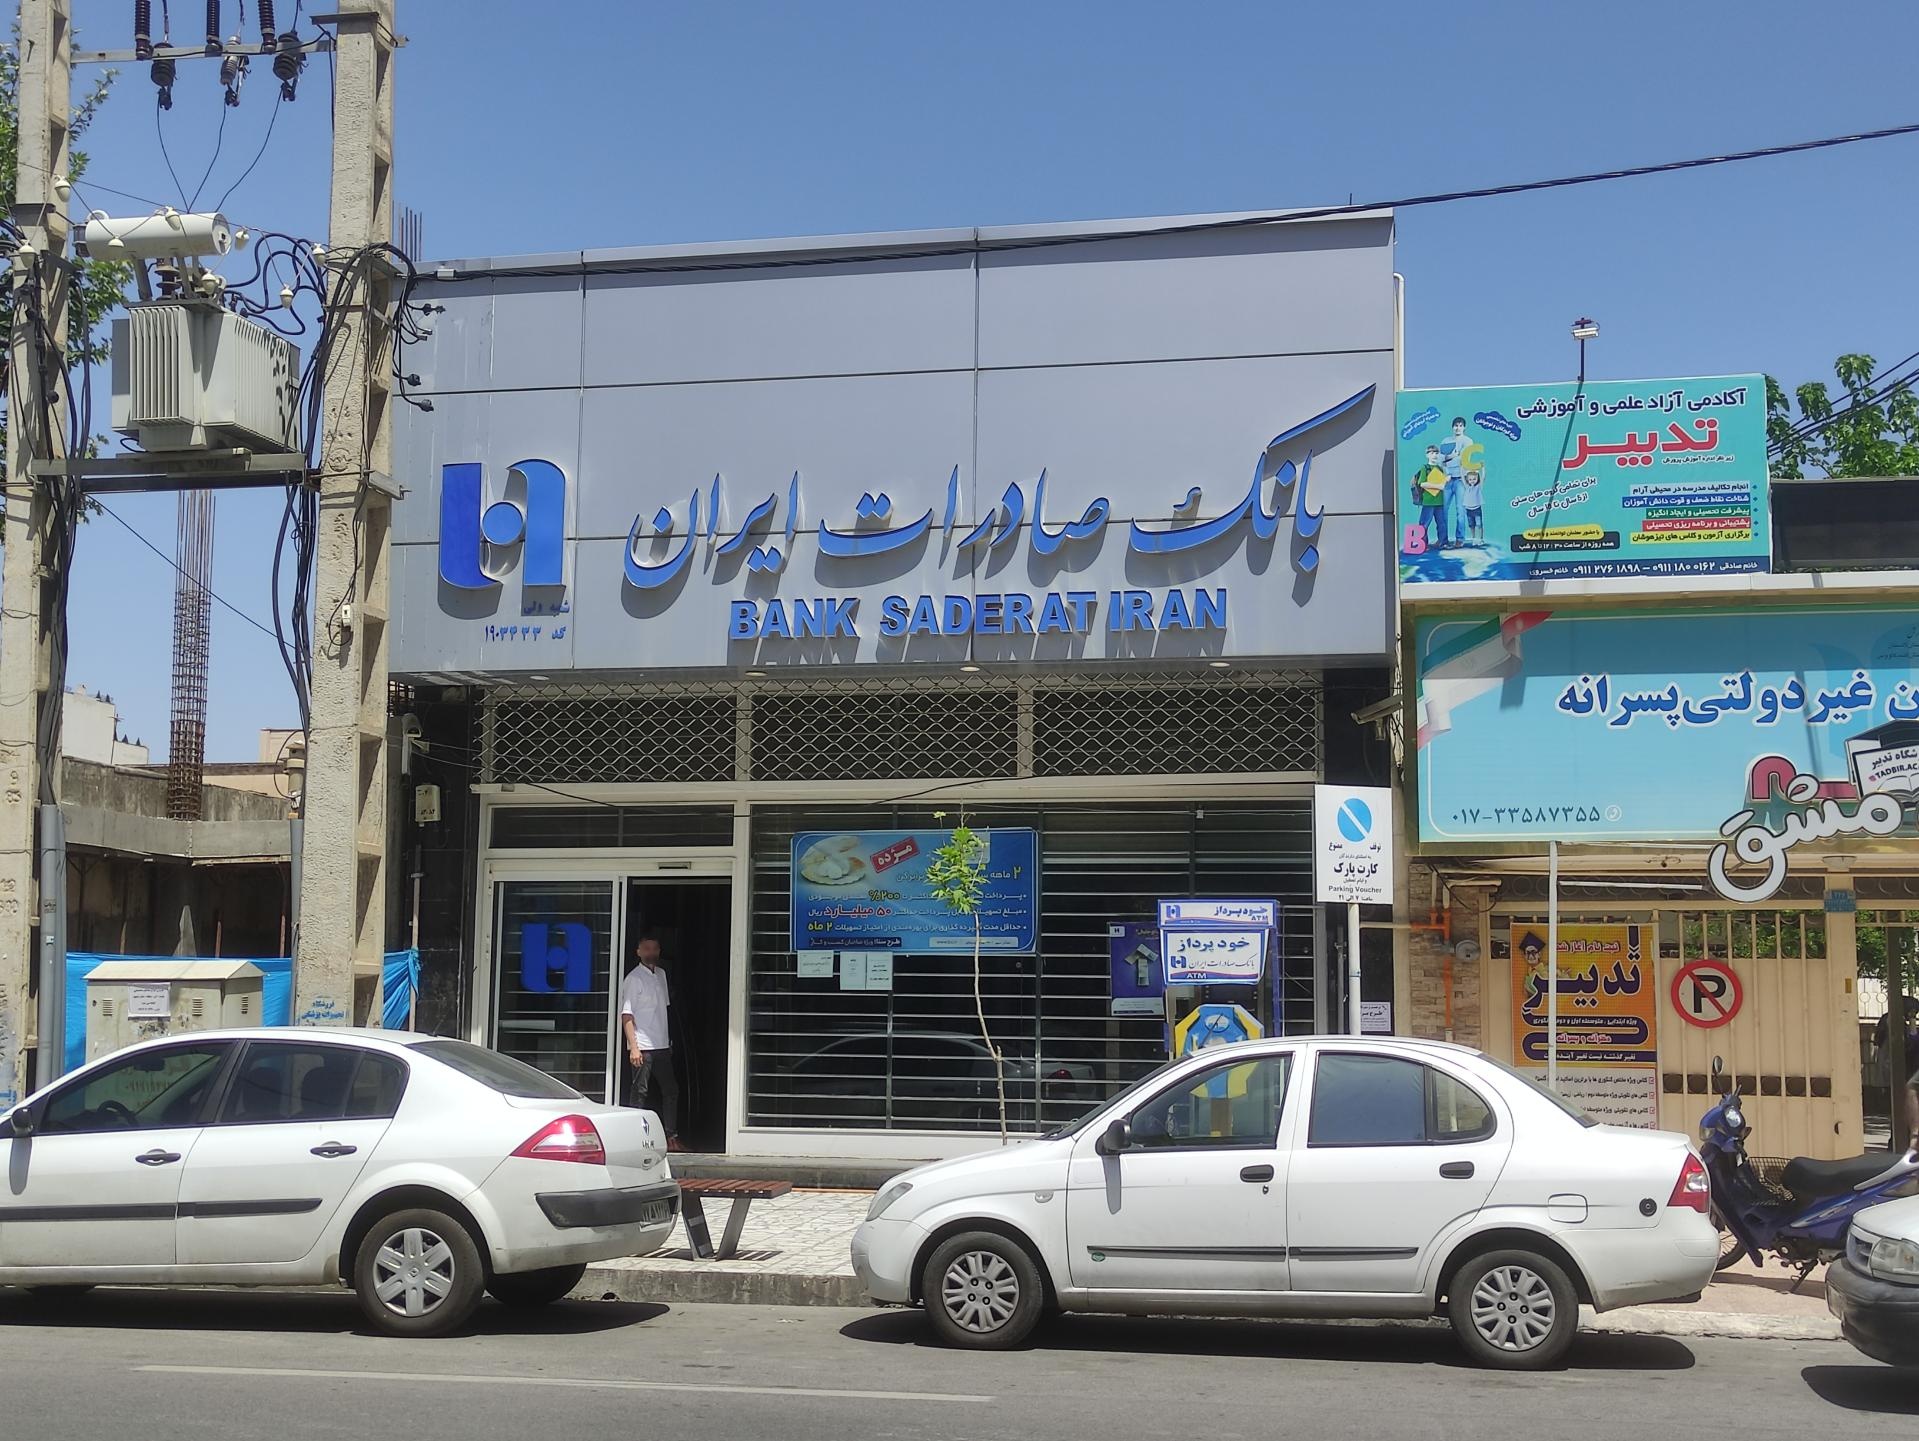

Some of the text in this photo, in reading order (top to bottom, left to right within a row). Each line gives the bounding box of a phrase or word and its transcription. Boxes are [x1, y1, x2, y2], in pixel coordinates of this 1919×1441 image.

[1518, 387, 1747, 418] آکادمی آزاد علمی و آموزشی
[1563, 419, 1718, 468] تدبیر
[624, 383, 1376, 589] بانک صادرات ایران
[1582, 476, 1597, 487] برای
[1560, 481, 1581, 494] تمامی
[1632, 486, 1648, 495] آرام
[1708, 484, 1731, 492] تکالیف
[1624, 498, 1648, 507] آموزان
[1693, 508, 1719, 517] تحصیلی
[1720, 507, 1750, 516] پیشرفت
[1646, 522, 1672, 530] تحصیلی
[1673, 521, 1691, 529] ریزی
[1691, 520, 1713, 528] برنامه
[1719, 519, 1750, 528] پشتیبانی
[1632, 533, 1664, 542] تیزهوشان
[1665, 532, 1678, 540] های
[1679, 531, 1696, 540] کلاس
[1704, 531, 1723, 540] آزمون
[1727, 530, 1750, 539] برگزاری
[1587, 541, 1601, 549] روزه
[1529, 562, 1758, 576] خانم صادقی ۰۱۶۲ ۱۸۰ ۰۹۱۱ ۱۸۹۸ ۲۷۶ ۰۹۱۱ خانم خسروی
[730, 588, 1227, 640] BANK SADERAT IRAN
[1557, 674, 1681, 727] پسرانه
[1872, 752, 1893, 770] تدبیر
[1452, 805, 1601, 825] ۰۱۷-۳۳۵۸۷۳۵۵
[877, 844, 913, 865] مژده
[990, 870, 1011, 879] ماهه
[1333, 862, 1379, 878] کارت پارک
[1328, 885, 1383, 894] Parking Voucher
[808, 909, 823, 917] ریال
[824, 904, 874, 918] میلیارد
[875, 907, 892, 917] ۵۰
[808, 921, 824, 931] ماه
[826, 922, 833, 931] ۲
[1000, 921, 1021, 931] حداقل
[1586, 940, 1601, 953] نام
[1188, 961, 1206, 969] ایران
[1522, 952, 1641, 1008] تدبیر
